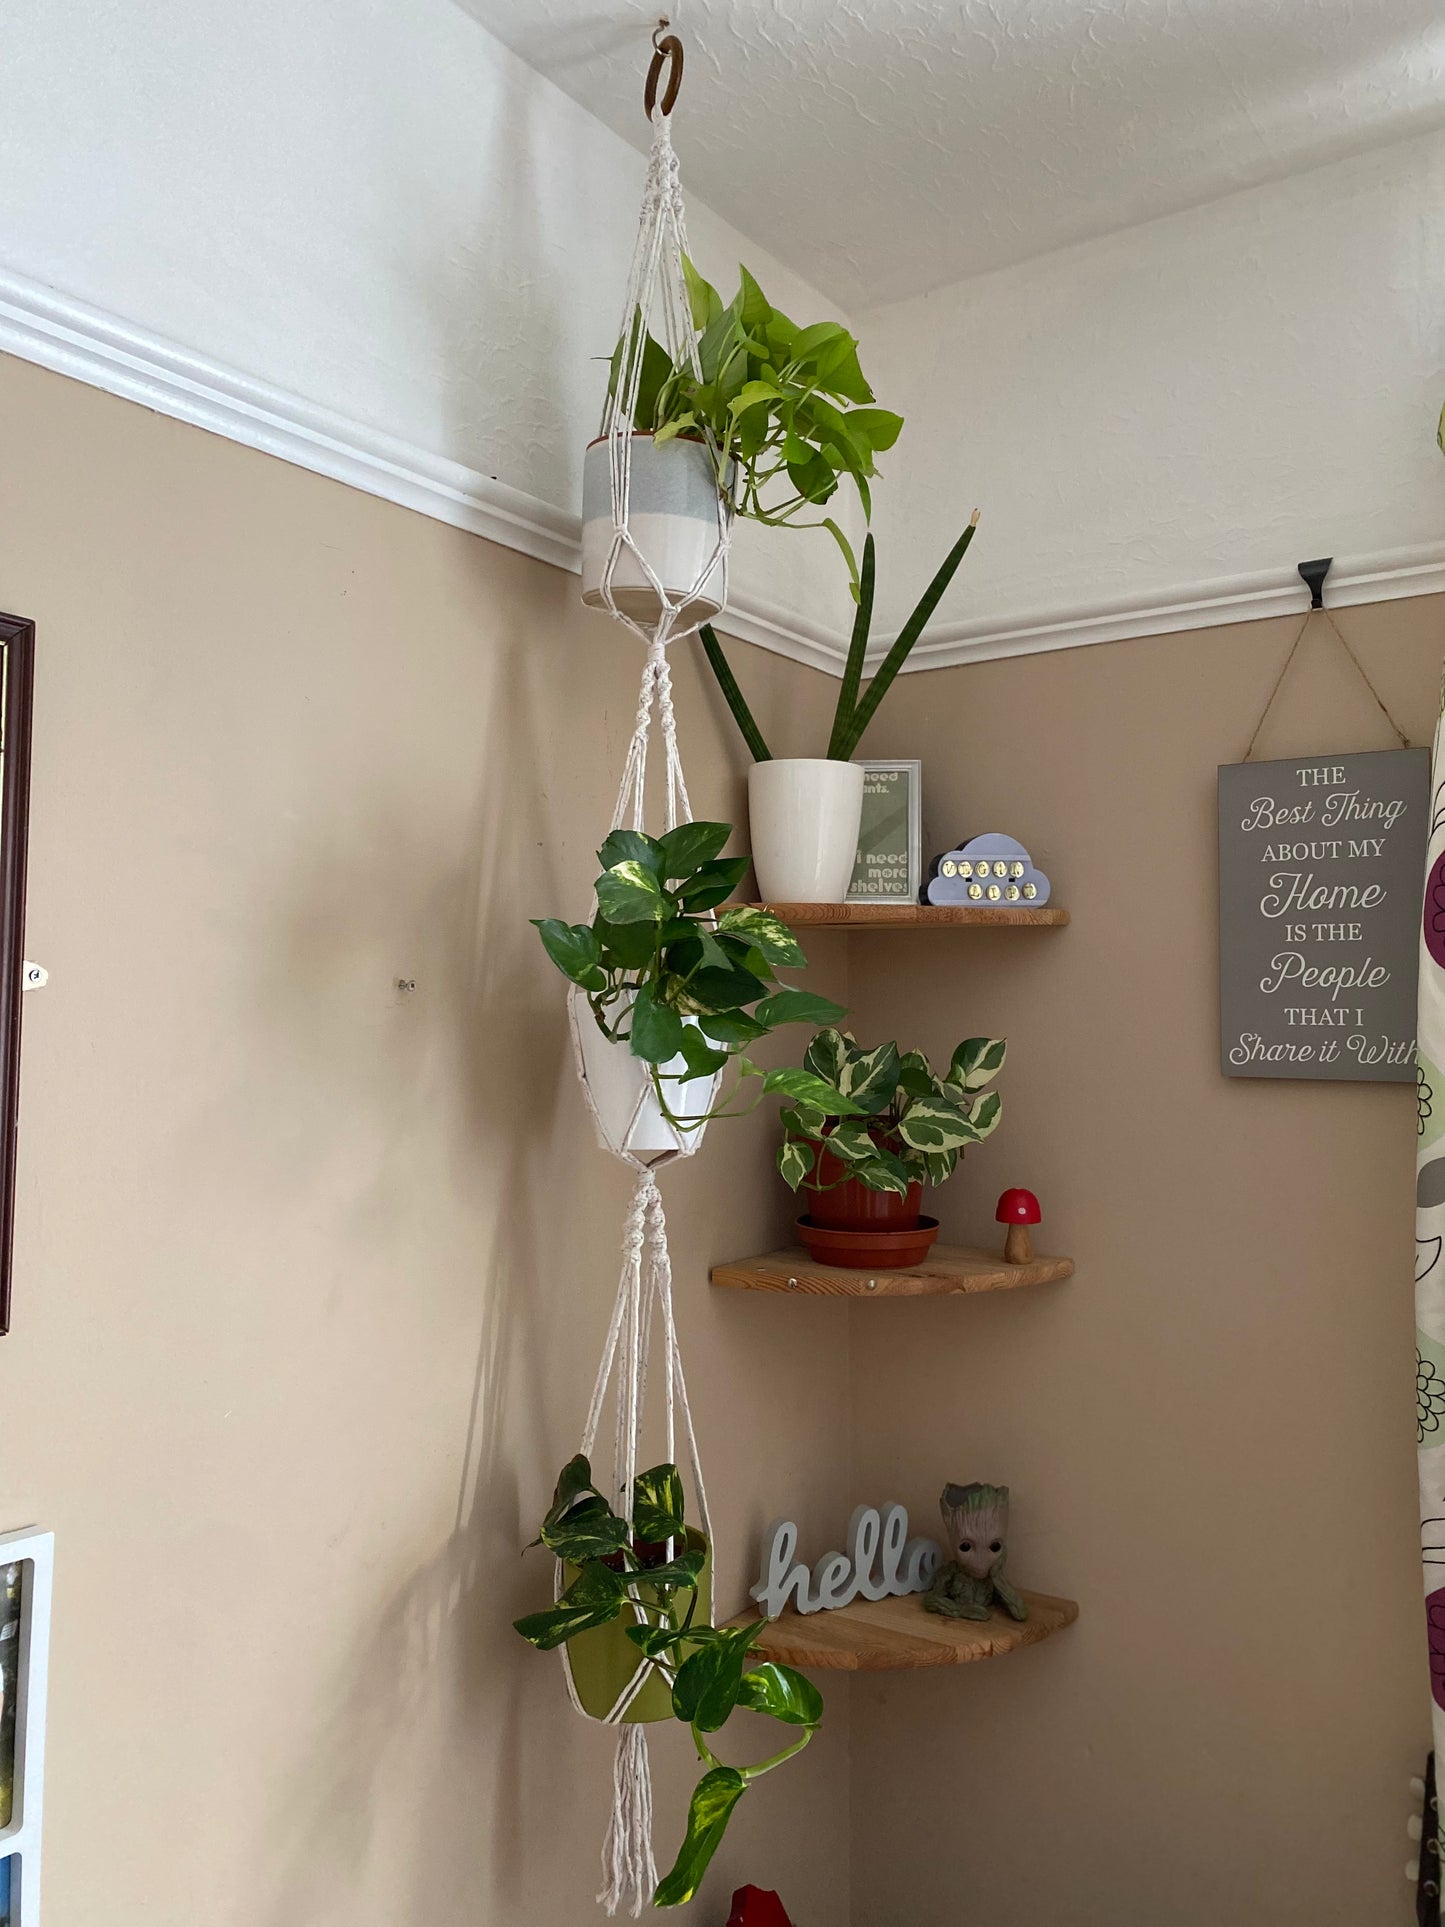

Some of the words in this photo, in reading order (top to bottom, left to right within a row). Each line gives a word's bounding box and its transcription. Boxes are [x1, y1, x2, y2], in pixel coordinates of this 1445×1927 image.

[864, 772, 898, 781] need
[1296, 766, 1346, 787] THE
[1241, 796, 1316, 832] Best
[1321, 790, 1408, 829] Thing
[857, 849, 862, 864] i
[866, 851, 907, 864] need
[1261, 841, 1342, 862] ABOUT
[1348, 838, 1386, 858] MY
[944, 862, 1022, 876] VEGAN
[1260, 872, 1387, 918] Home
[1284, 924, 1306, 942] IS
[1312, 923, 1362, 941] THE
[1260, 952, 1391, 1001] People
[1284, 1008, 1349, 1026] THAT
[1355, 1008, 1364, 1026] I
[1229, 1033, 1316, 1065] Share
[1319, 1040, 1341, 1062] it
[1346, 1034, 1418, 1065] With
[755, 1503, 941, 1622] hello
